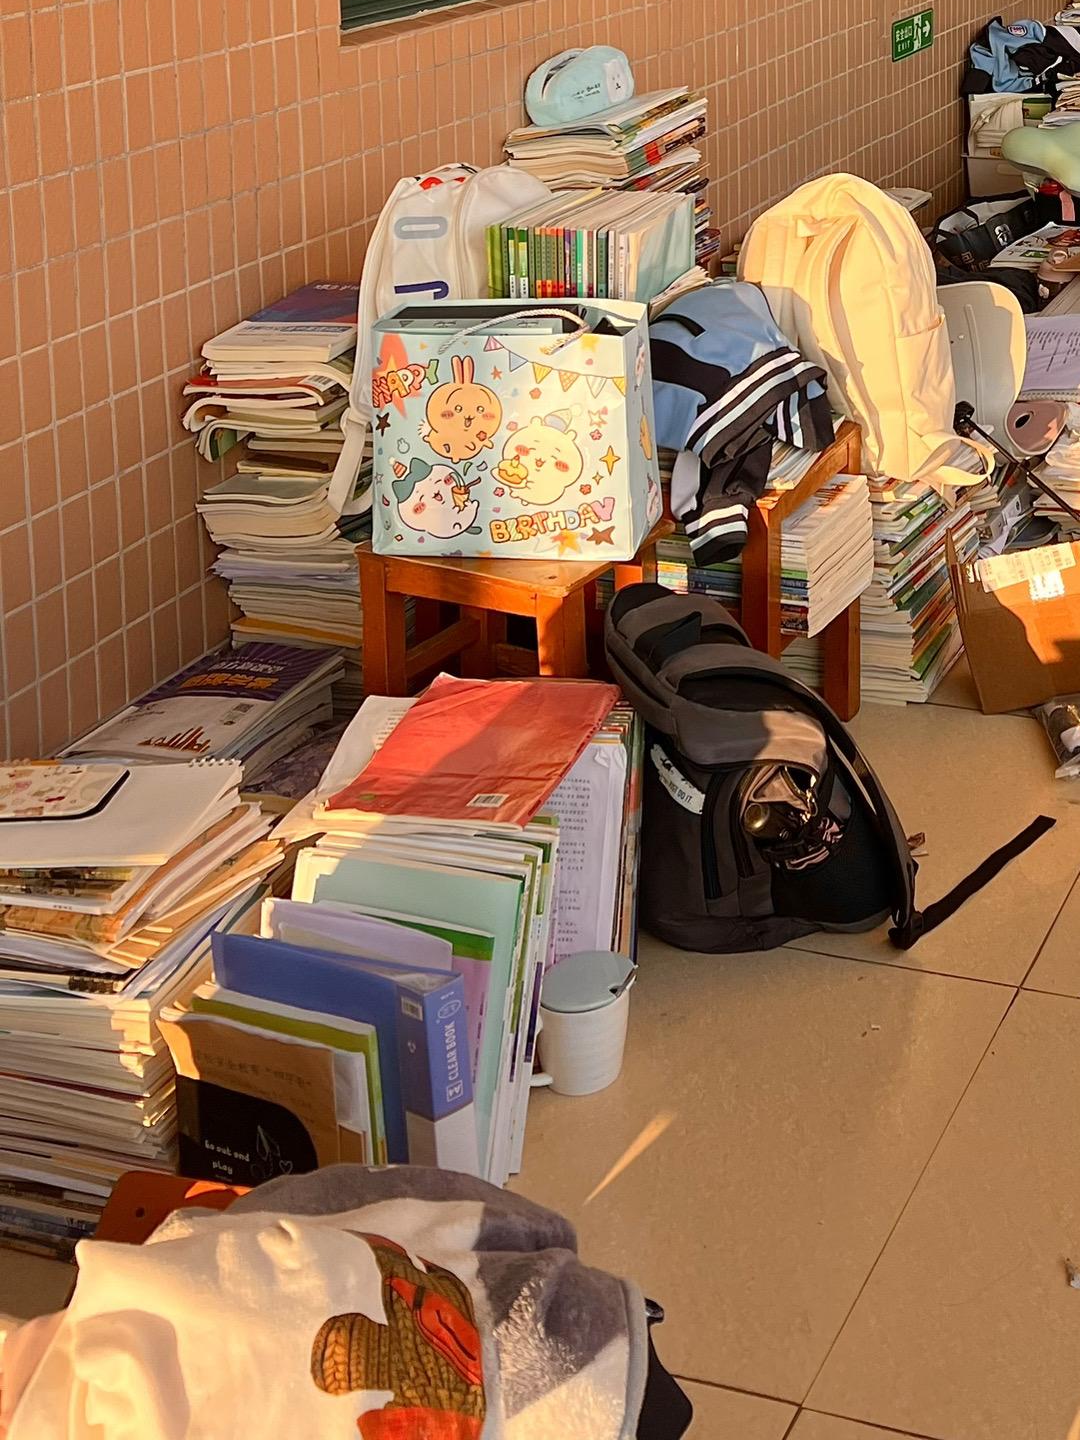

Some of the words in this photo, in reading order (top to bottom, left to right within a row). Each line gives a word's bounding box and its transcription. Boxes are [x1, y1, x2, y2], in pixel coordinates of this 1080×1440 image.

[372, 358, 440, 408] HAPPY
[444, 1020, 457, 1051] BOOK
[446, 1050, 459, 1081] CLEAR
[212, 1161, 233, 1175] play
